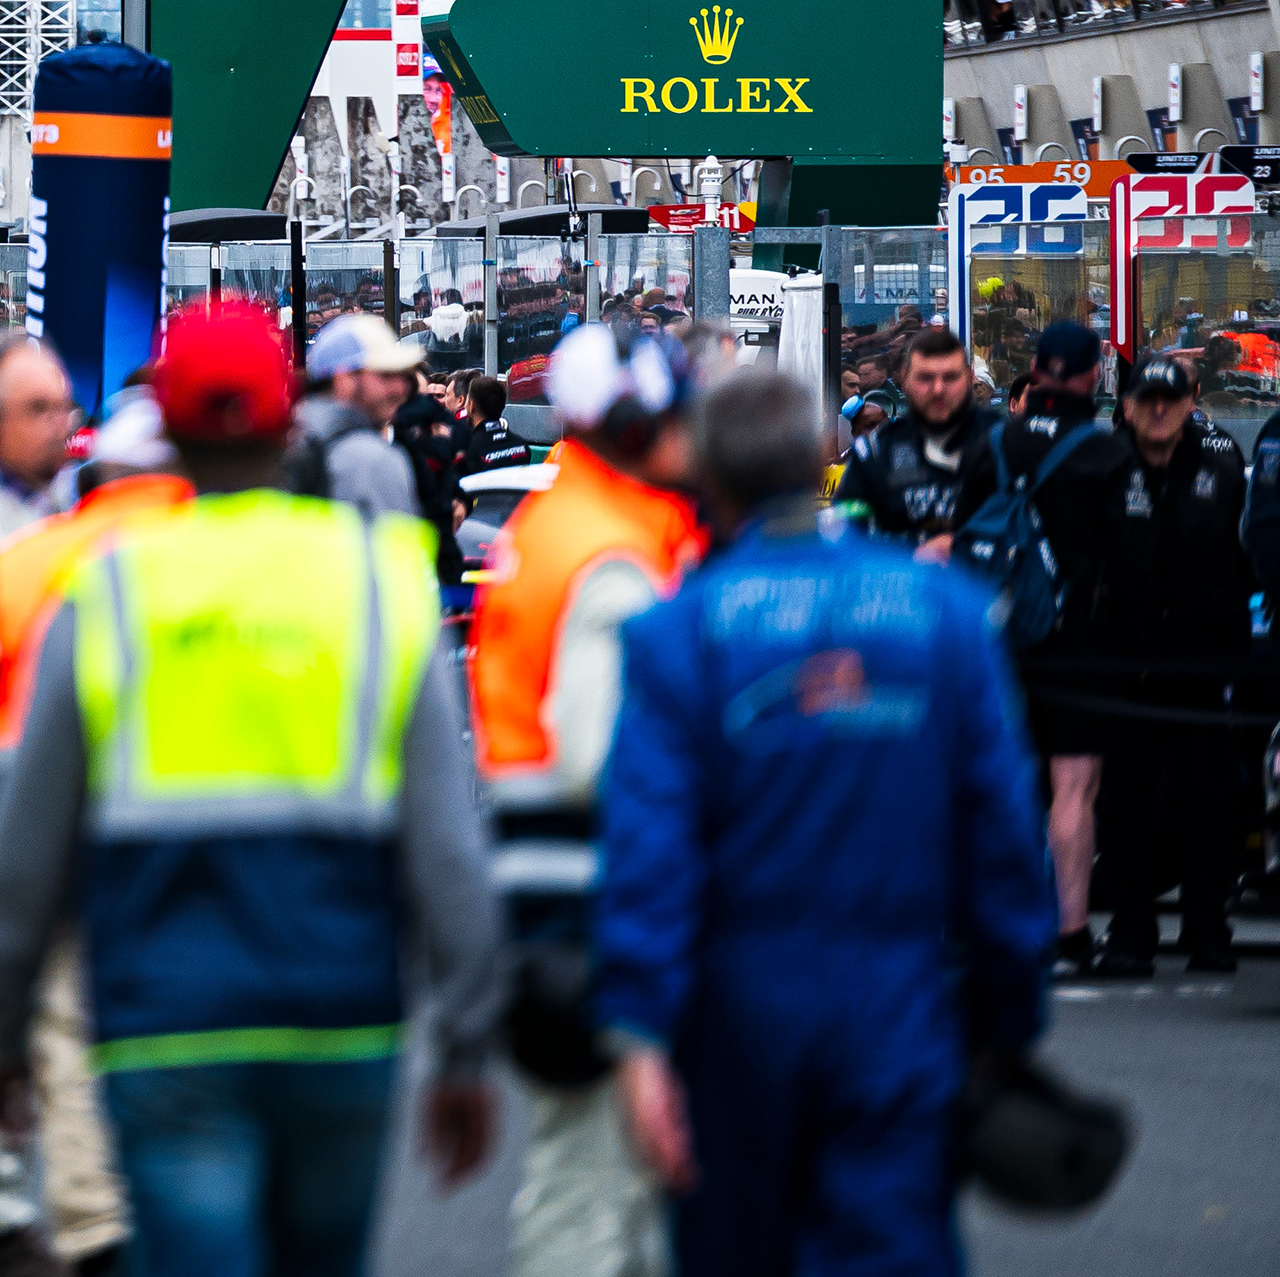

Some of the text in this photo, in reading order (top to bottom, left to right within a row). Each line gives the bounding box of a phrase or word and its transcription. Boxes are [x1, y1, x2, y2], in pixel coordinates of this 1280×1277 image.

[620, 77, 813, 113] ROLEX
[968, 168, 1004, 184] 95
[1052, 163, 1091, 186] 59
[1253, 165, 1271, 178] 23
[715, 206, 740, 229] 11
